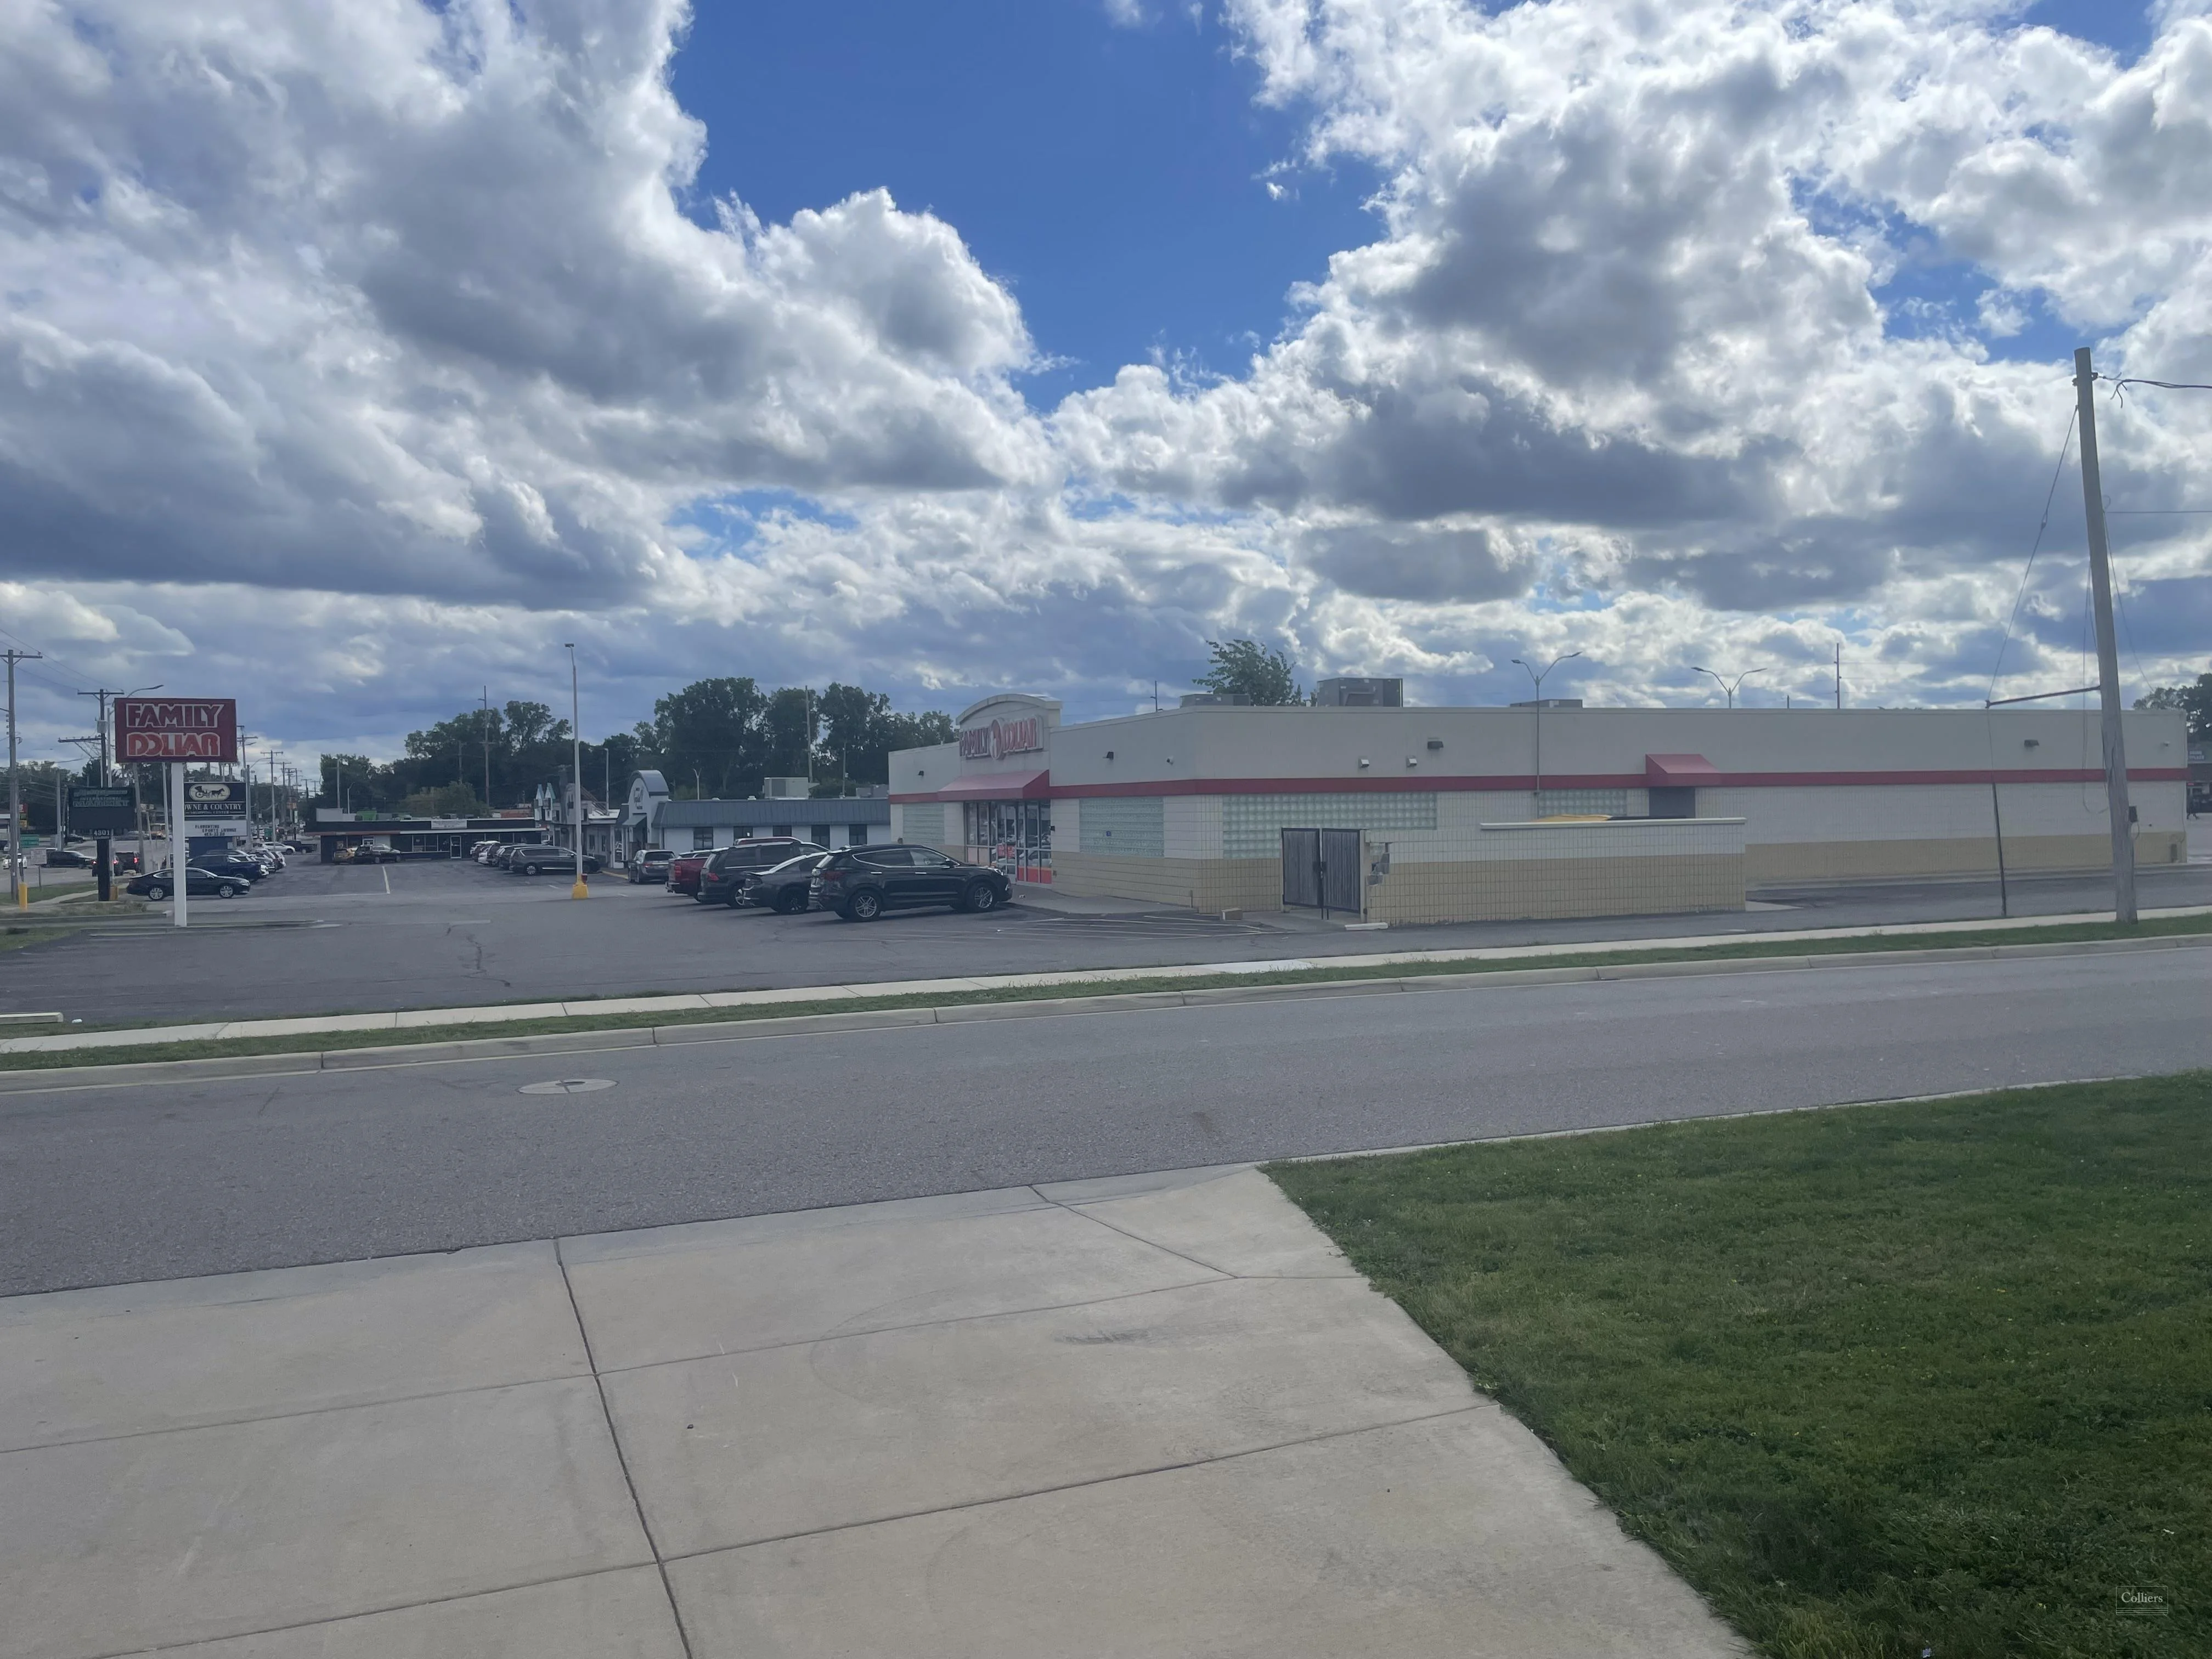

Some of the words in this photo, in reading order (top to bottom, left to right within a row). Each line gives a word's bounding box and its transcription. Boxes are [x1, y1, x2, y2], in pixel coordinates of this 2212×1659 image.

[126, 703, 224, 727] FAMILY
[127, 732, 220, 757] DOLLAR
[960, 726, 990, 757] FAMILY
[1001, 715, 1038, 753] DOLLAR
